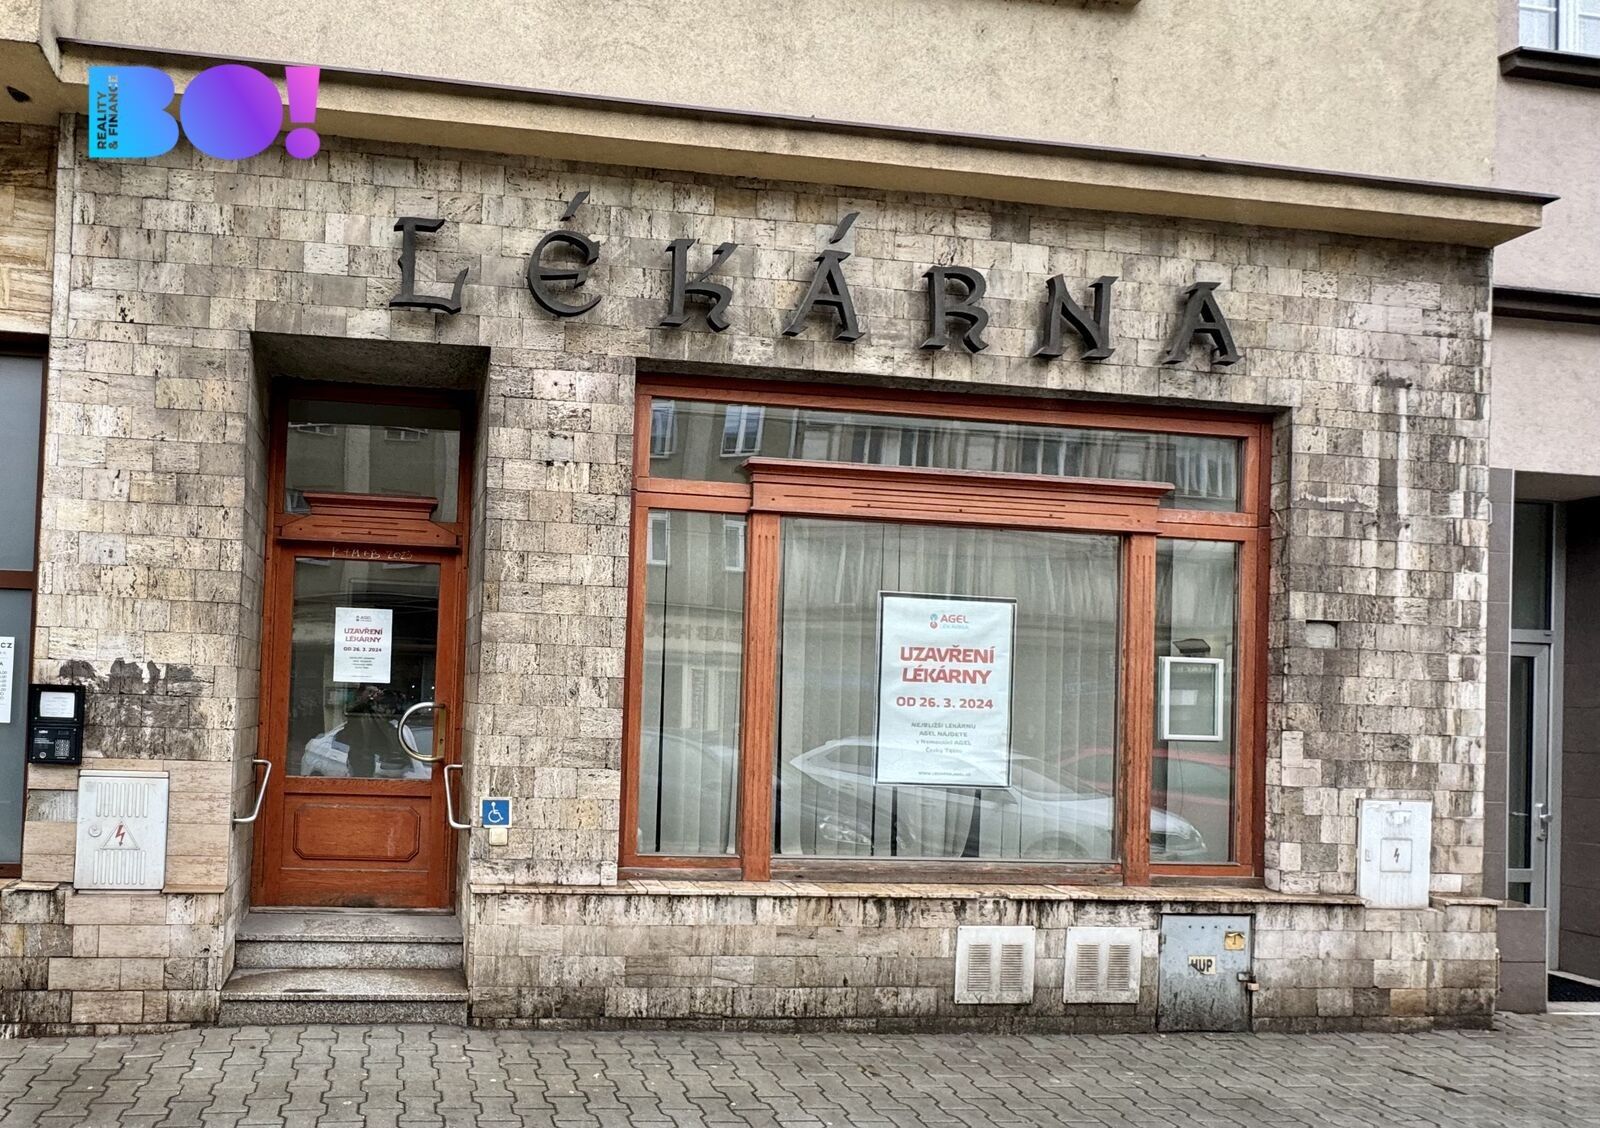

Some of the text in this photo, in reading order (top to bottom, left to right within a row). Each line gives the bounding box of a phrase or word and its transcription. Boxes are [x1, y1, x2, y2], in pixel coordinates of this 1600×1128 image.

[389, 191, 1242, 366] LÉKÁRNA
[940, 614, 969, 624] AGEL
[344, 627, 383, 635] UZAVŘENÍ
[900, 644, 996, 664] UZAVŘENÍ
[902, 664, 993, 685] LÉKÁRNY
[896, 696, 994, 709] OD 26. 3. 2024
